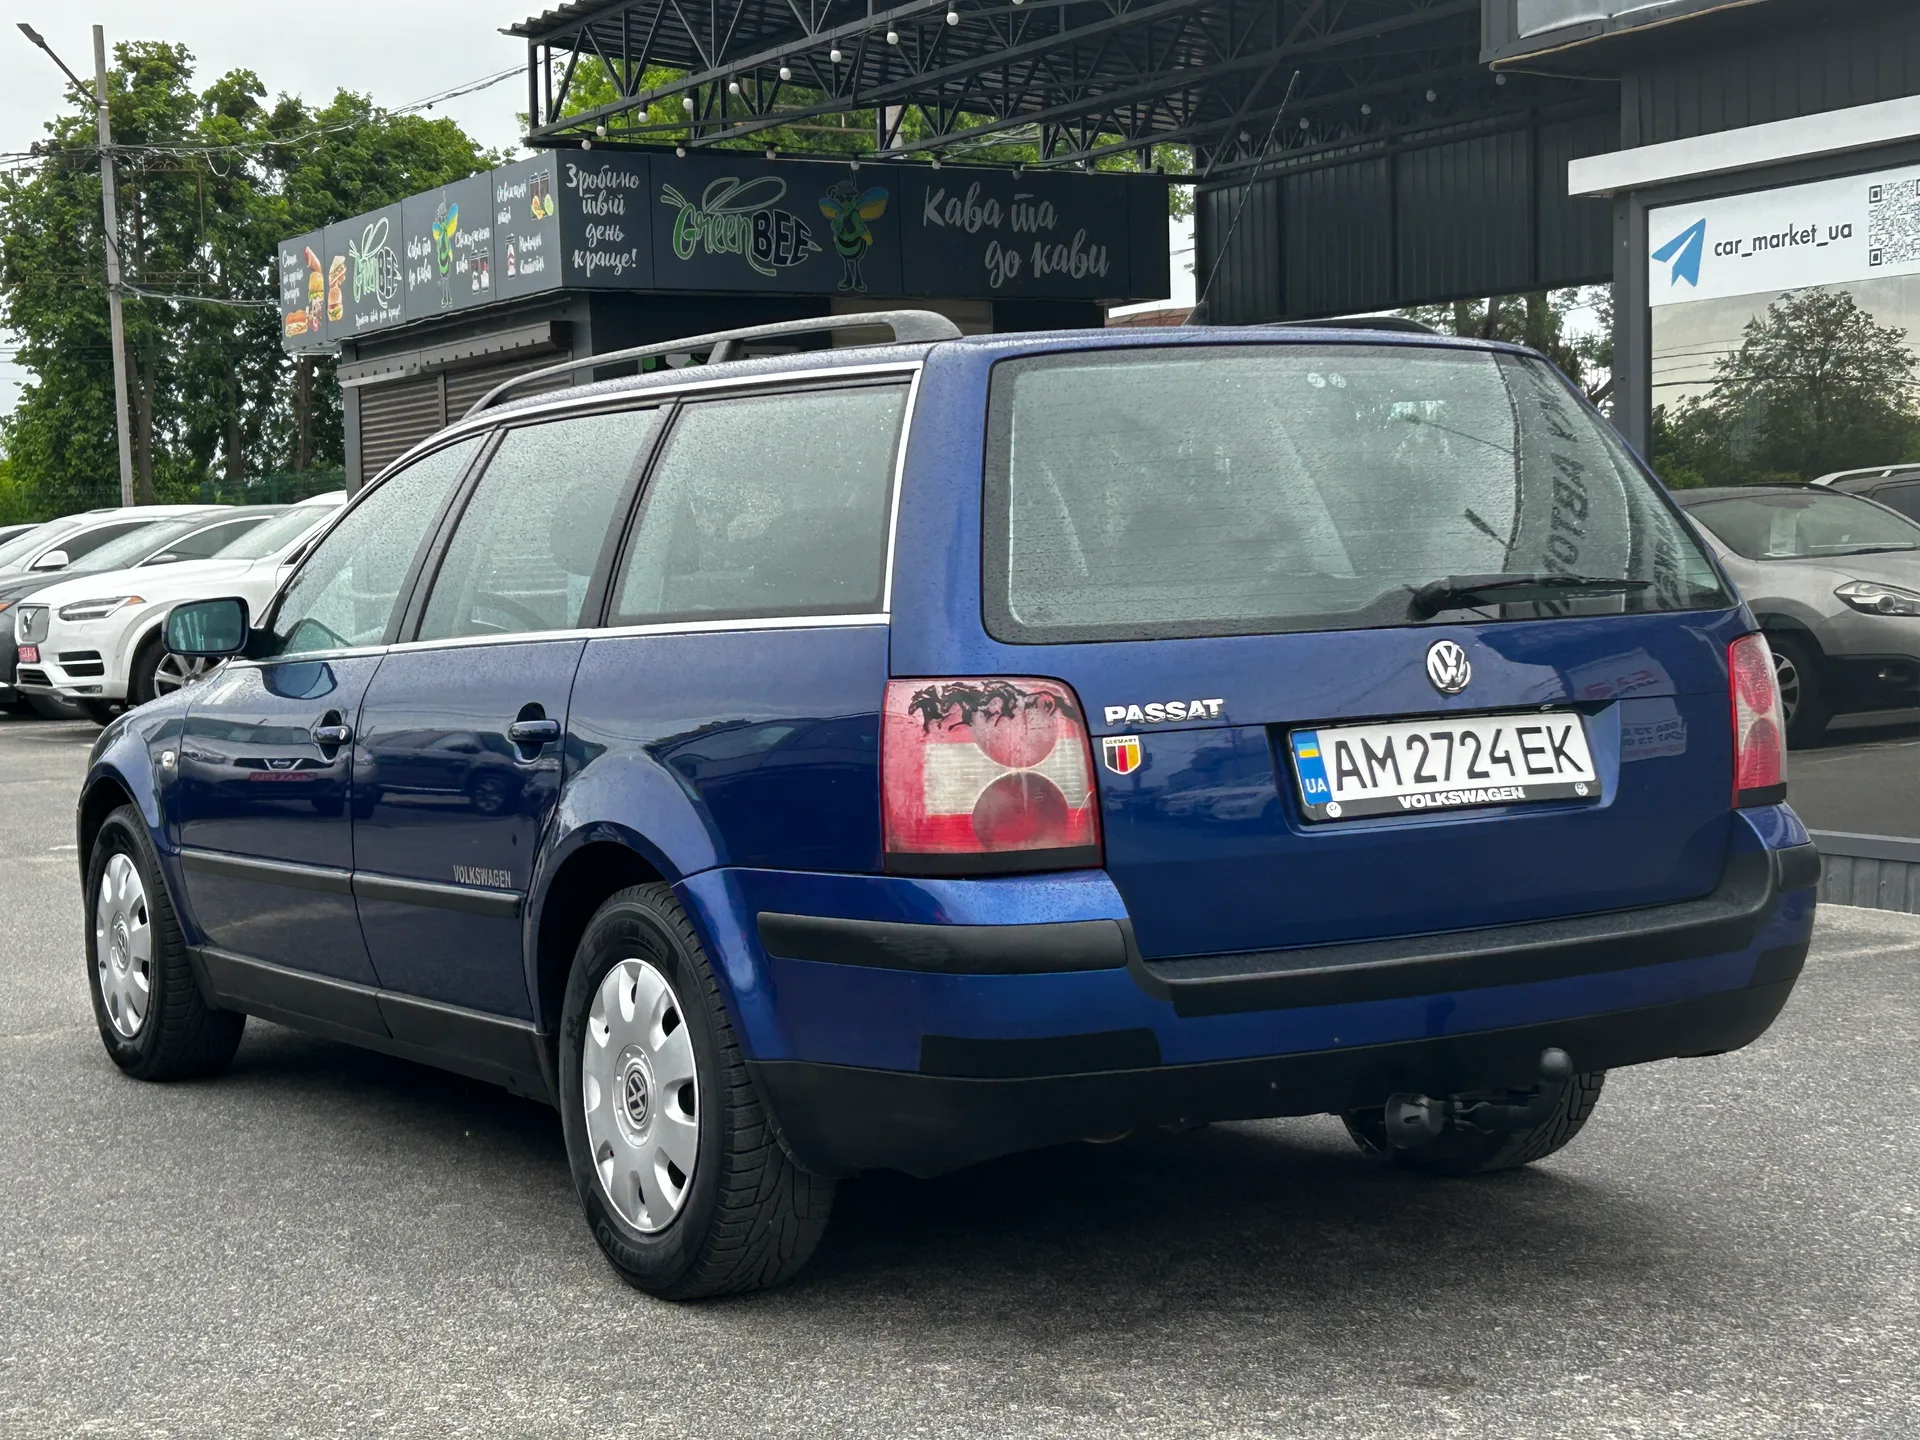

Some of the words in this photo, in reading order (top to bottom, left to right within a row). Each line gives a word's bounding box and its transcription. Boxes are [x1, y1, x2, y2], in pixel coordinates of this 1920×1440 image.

[566, 163, 640, 196] Зробимо
[582, 189, 626, 217] твій
[922, 181, 1004, 233] Кава
[1011, 193, 1058, 233] та
[585, 222, 625, 248] день
[1714, 222, 1853, 258] car_market_ua
[572, 248, 638, 278] краще!
[984, 240, 1022, 288] до
[1030, 228, 1110, 279] кави
[1104, 698, 1224, 726] PASSAT
[1304, 777, 1328, 794] UA
[1397, 786, 1526, 809] VOLKSWAGEN
[453, 864, 512, 888] VOLKSWAGEN
